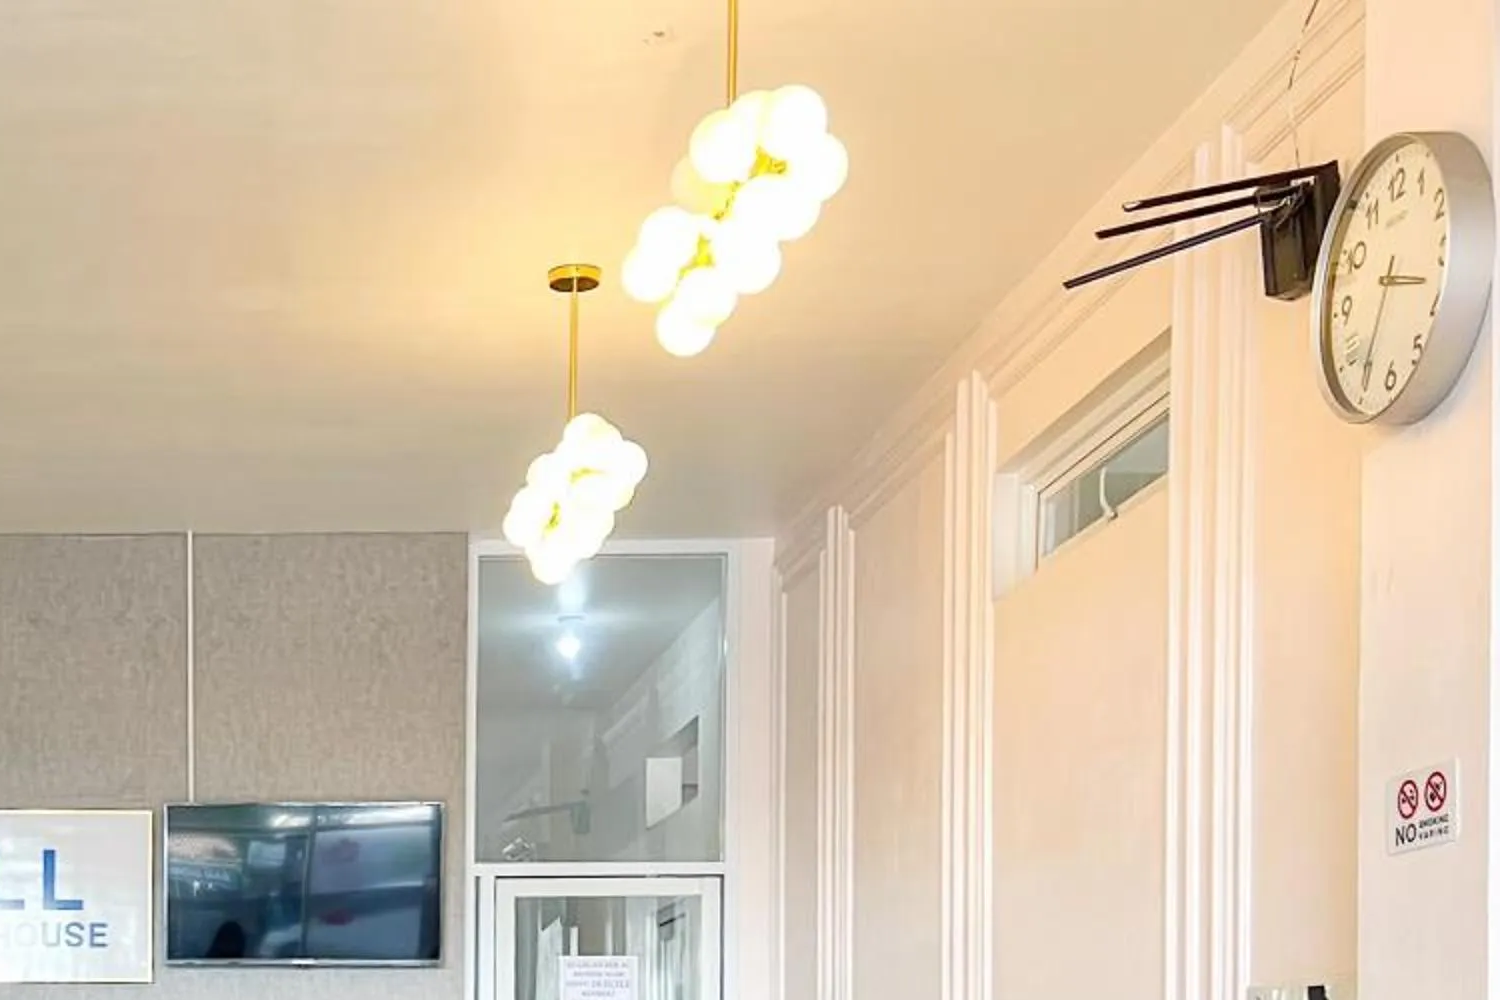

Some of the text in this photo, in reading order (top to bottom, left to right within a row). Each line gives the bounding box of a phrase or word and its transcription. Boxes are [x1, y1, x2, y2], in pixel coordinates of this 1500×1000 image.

[1387, 167, 1406, 203] 12
[1417, 166, 1425, 197] 1
[1365, 197, 1379, 231] 11
[1433, 187, 1445, 221] 2
[1347, 240, 1367, 275] 10
[1341, 295, 1353, 327] 9
[1412, 333, 1424, 366] 5
[1384, 359, 1398, 392] 6
[1394, 823, 1417, 847] NO
